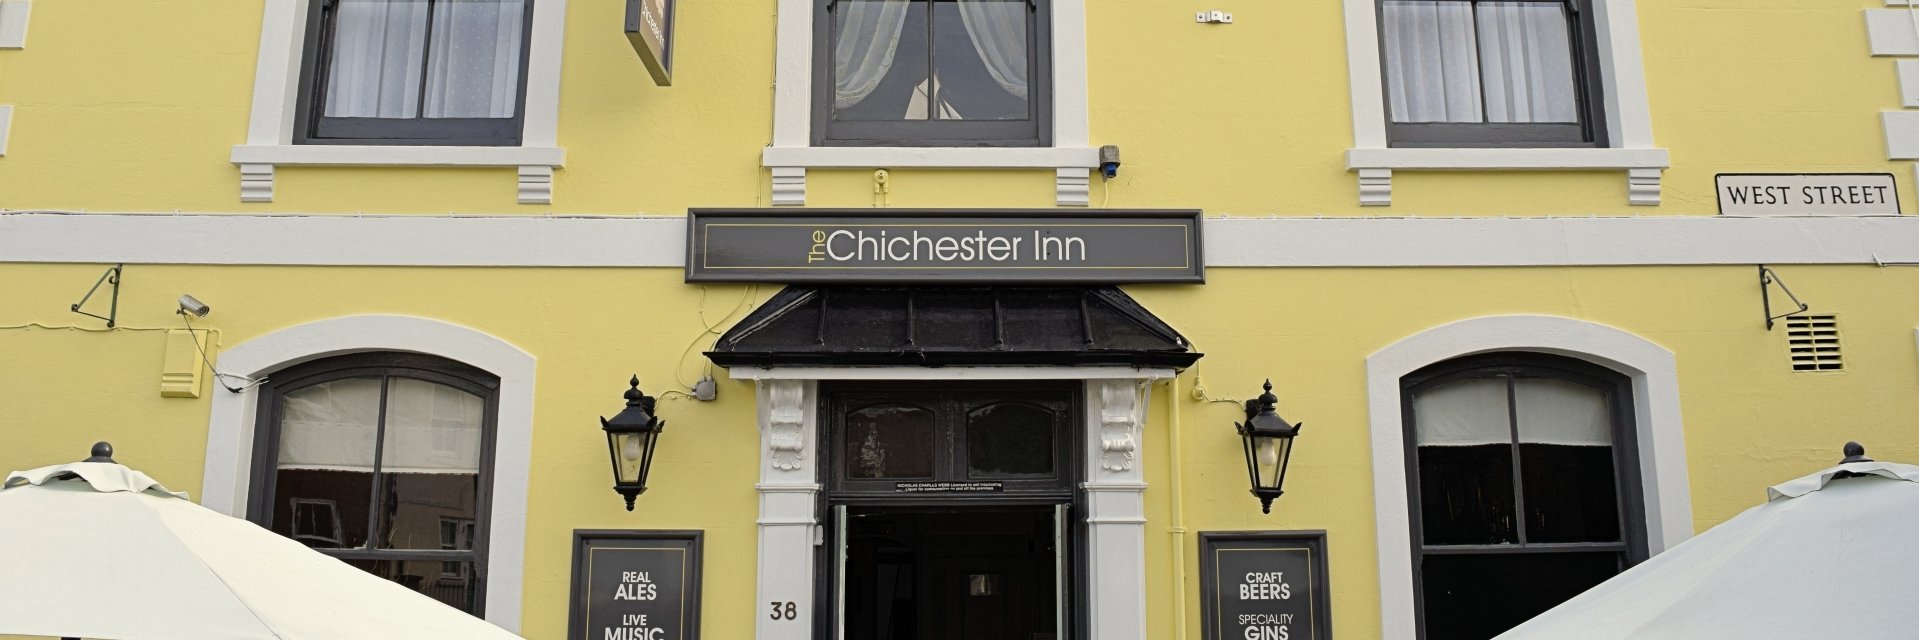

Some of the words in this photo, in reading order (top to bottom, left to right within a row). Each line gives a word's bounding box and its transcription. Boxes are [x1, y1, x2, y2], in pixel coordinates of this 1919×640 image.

[1727, 186, 1791, 205] WEST
[1802, 185, 1887, 204] STREET
[808, 229, 826, 263] The
[826, 229, 1022, 261] Chichester
[1034, 230, 1086, 261] Inn
[622, 571, 651, 583] REAL
[1245, 572, 1283, 583] CRAFT
[614, 583, 657, 600] ALES
[1240, 583, 1291, 600] BEERS
[770, 601, 797, 620] 38
[622, 614, 647, 626] LIVE
[1238, 613, 1294, 625] SPECIALITY
[604, 627, 665, 640] MUSIC
[1244, 625, 1289, 640] GINS
